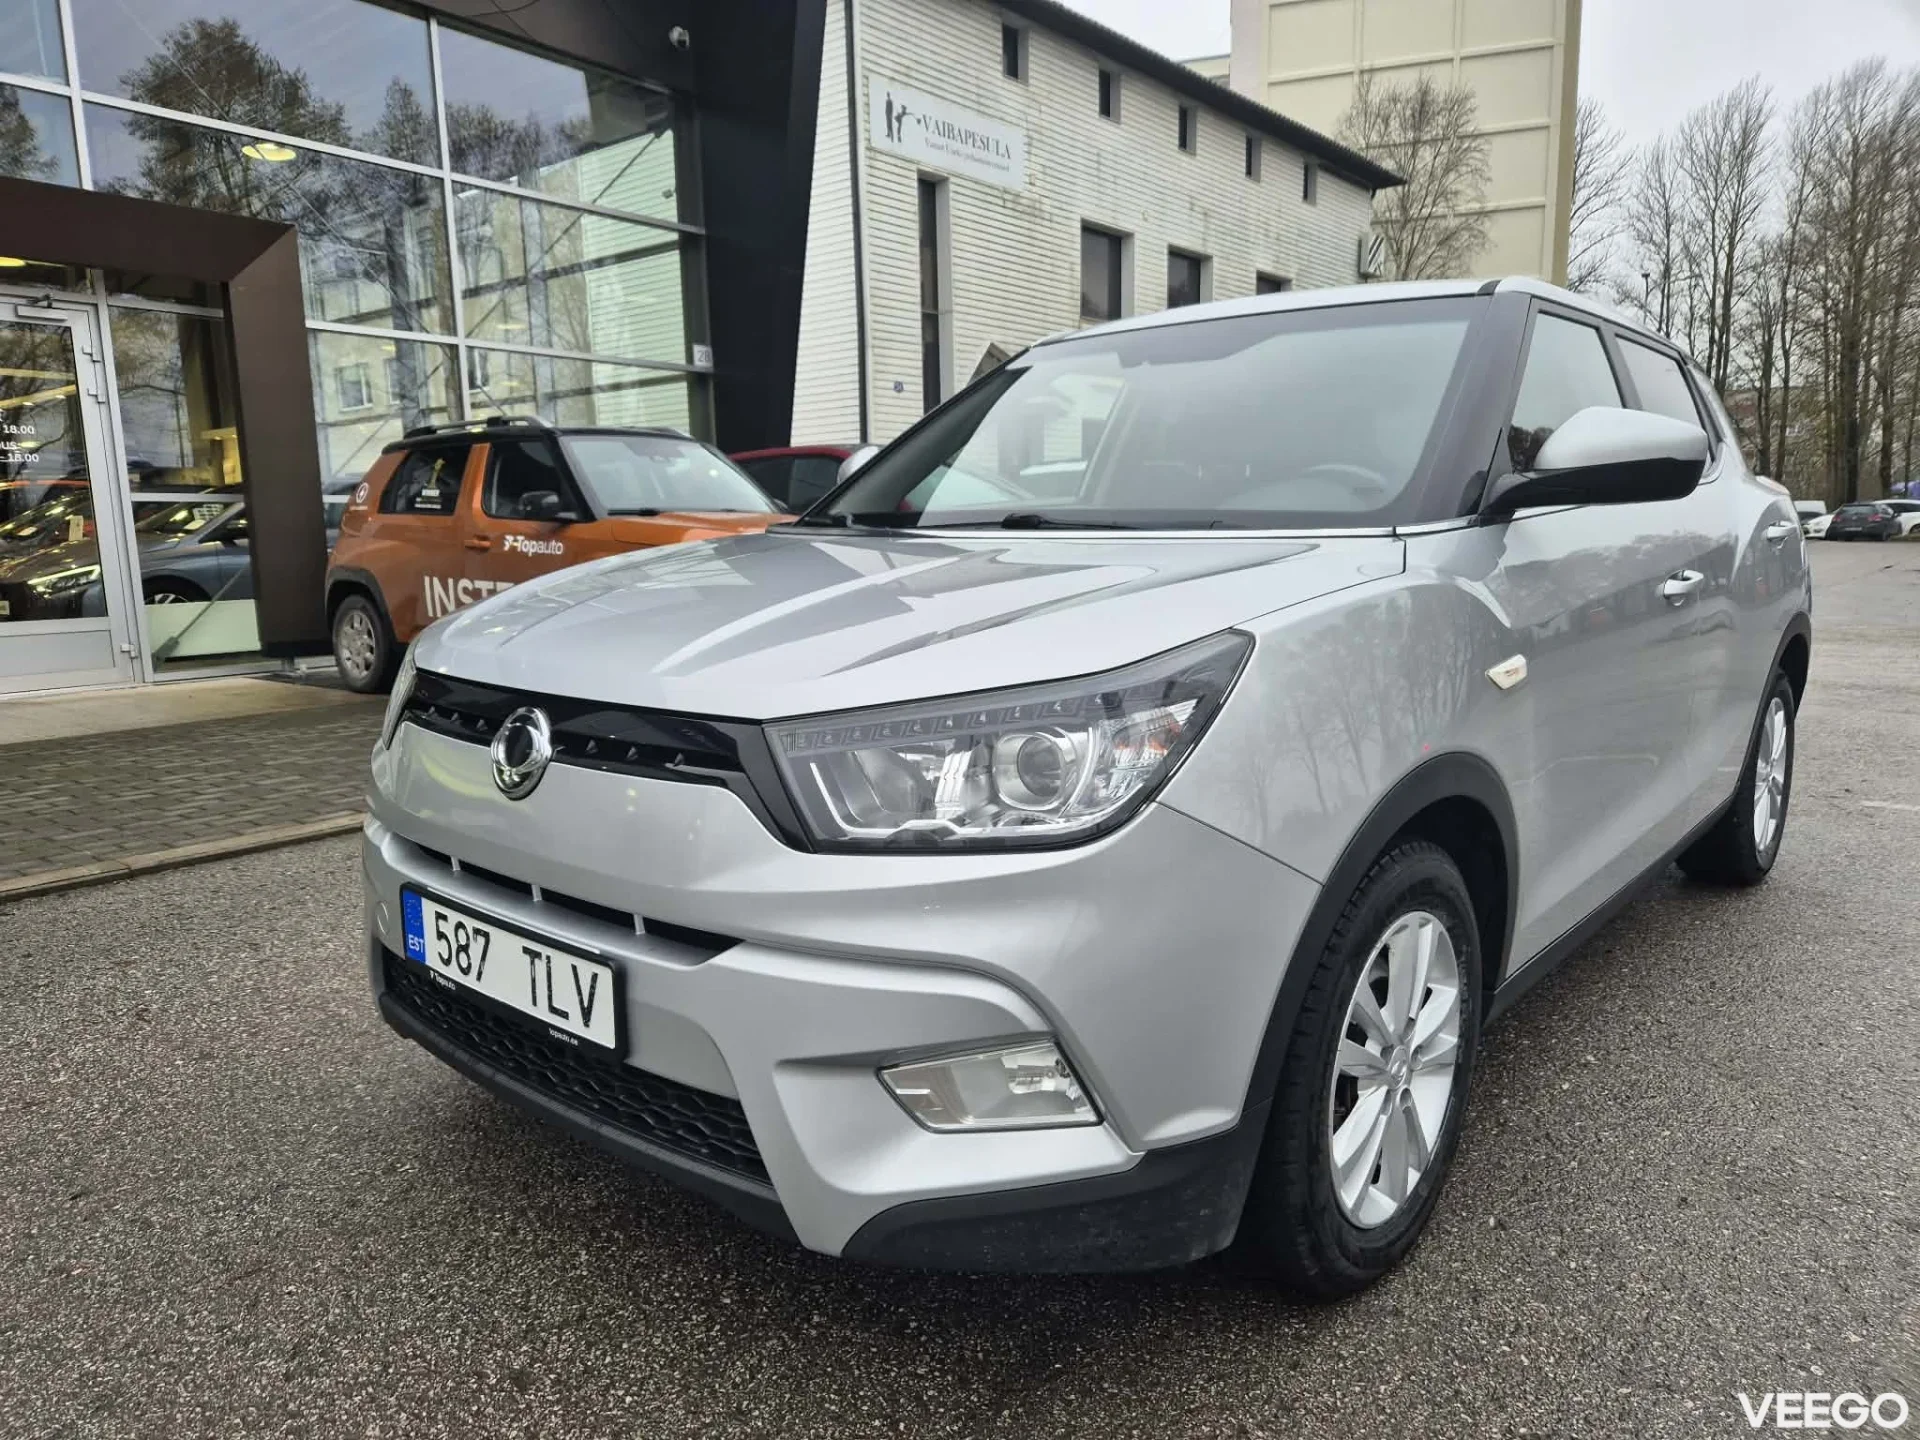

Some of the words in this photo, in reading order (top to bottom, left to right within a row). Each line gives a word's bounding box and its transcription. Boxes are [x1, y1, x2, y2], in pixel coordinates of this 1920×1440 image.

[922, 114, 1011, 160] VAIBAPESULA
[3, 424, 35, 435] 18.00
[516, 535, 564, 557] Topauto
[424, 575, 515, 618] INST
[408, 934, 425, 953] EST
[434, 910, 491, 982] 587
[522, 945, 599, 1029] TLV
